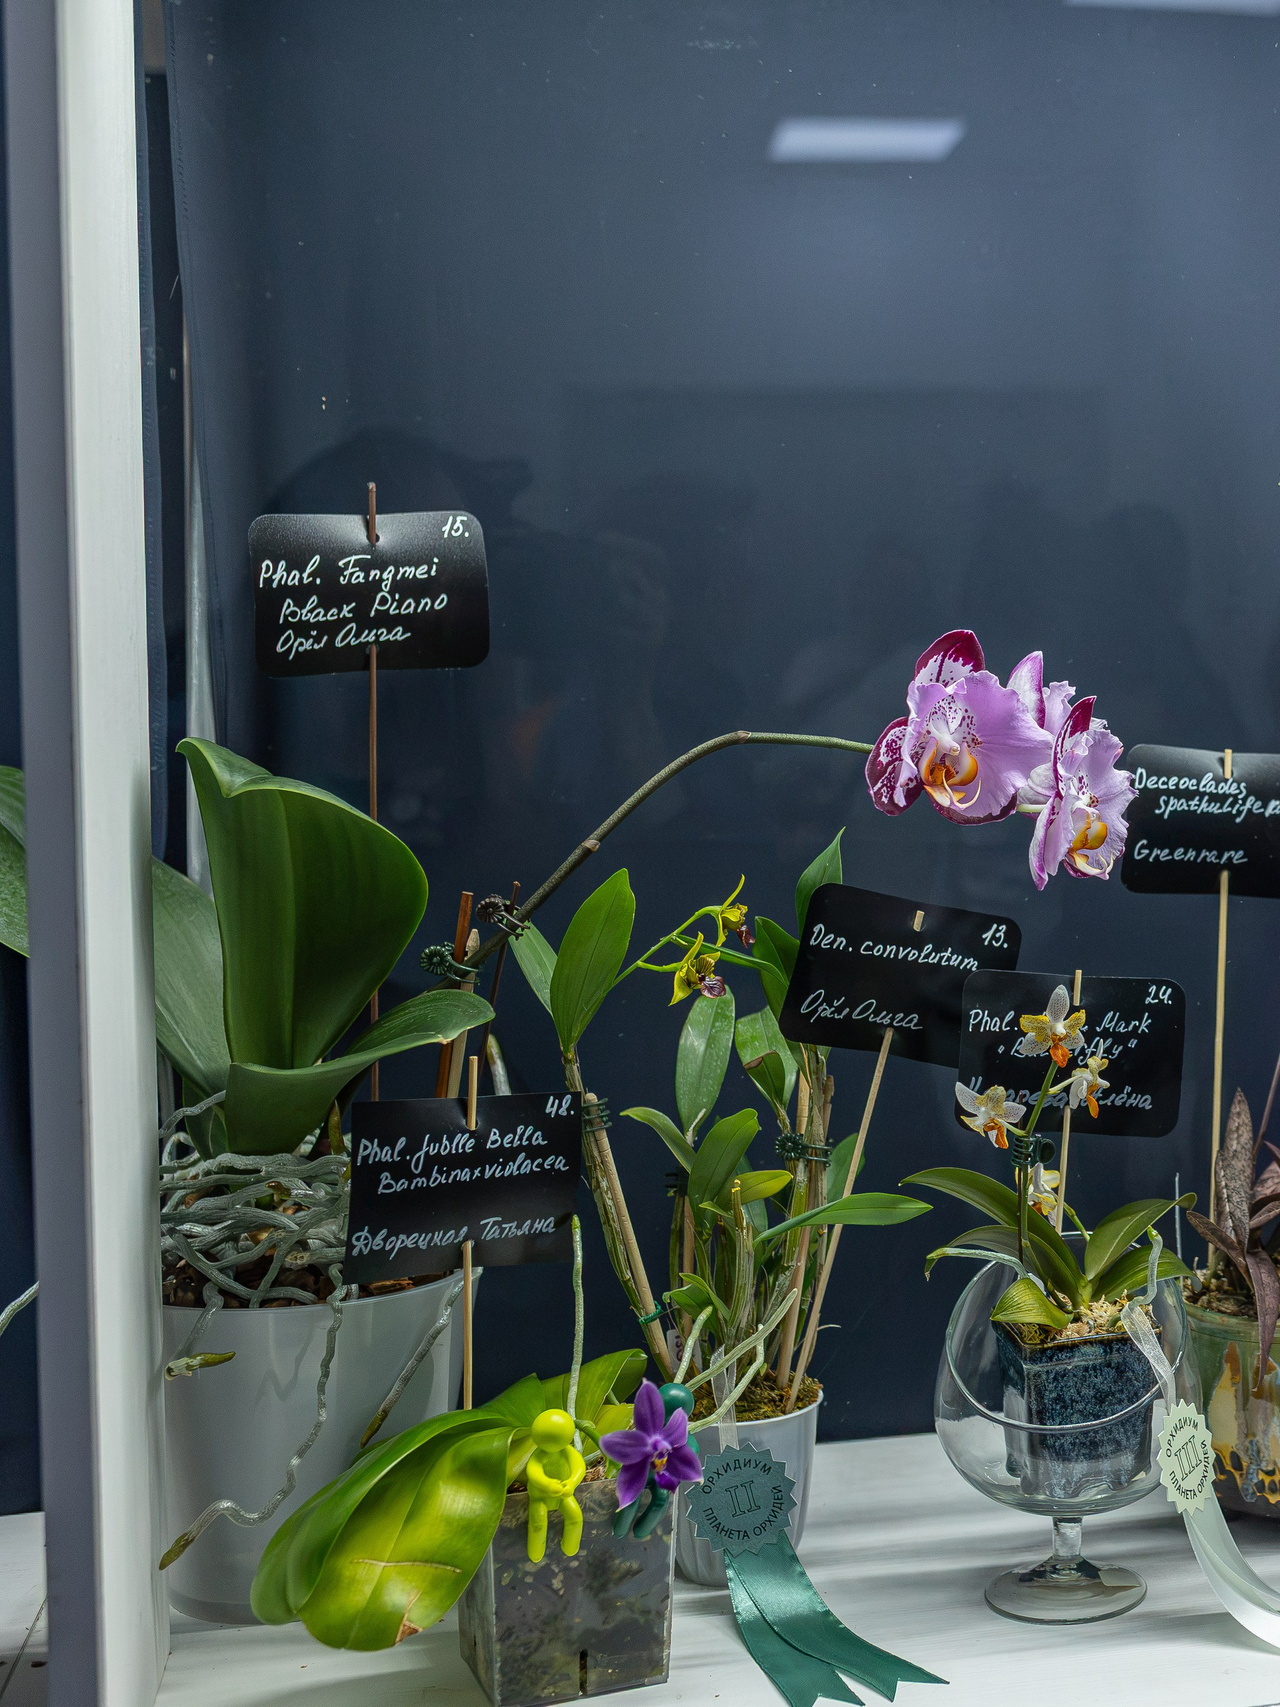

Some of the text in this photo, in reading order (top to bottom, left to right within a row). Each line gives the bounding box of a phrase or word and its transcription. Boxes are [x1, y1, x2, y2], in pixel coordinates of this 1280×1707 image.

[442, 516, 469, 538] 15.
[259, 555, 439, 591] Phal. Fangmei
[280, 592, 448, 624] Black Piano
[1133, 839, 1248, 864] Greenrare
[810, 923, 979, 972] Den. convolutum
[982, 924, 1008, 948] 13.
[1145, 985, 1173, 1004] 24.
[968, 1009, 1018, 1033] Phal.
[1096, 1011, 1152, 1034] Mark
[545, 1095, 575, 1118] 48.
[357, 1137, 410, 1166] Phal.
[486, 1125, 548, 1149] Bella
[480, 1216, 556, 1241] Татьяна
[1166, 1417, 1198, 1457] ОРХИДИУМ
[1169, 1440, 1210, 1500] ПЛАНЕТА ОРХИДЕЙ
[1174, 1435, 1202, 1481] III
[701, 1458, 772, 1494] ОРХИДИУМ
[703, 1485, 784, 1540] ПЛАНЕТА ОРХИДЕЙ
[725, 1480, 760, 1518] II
